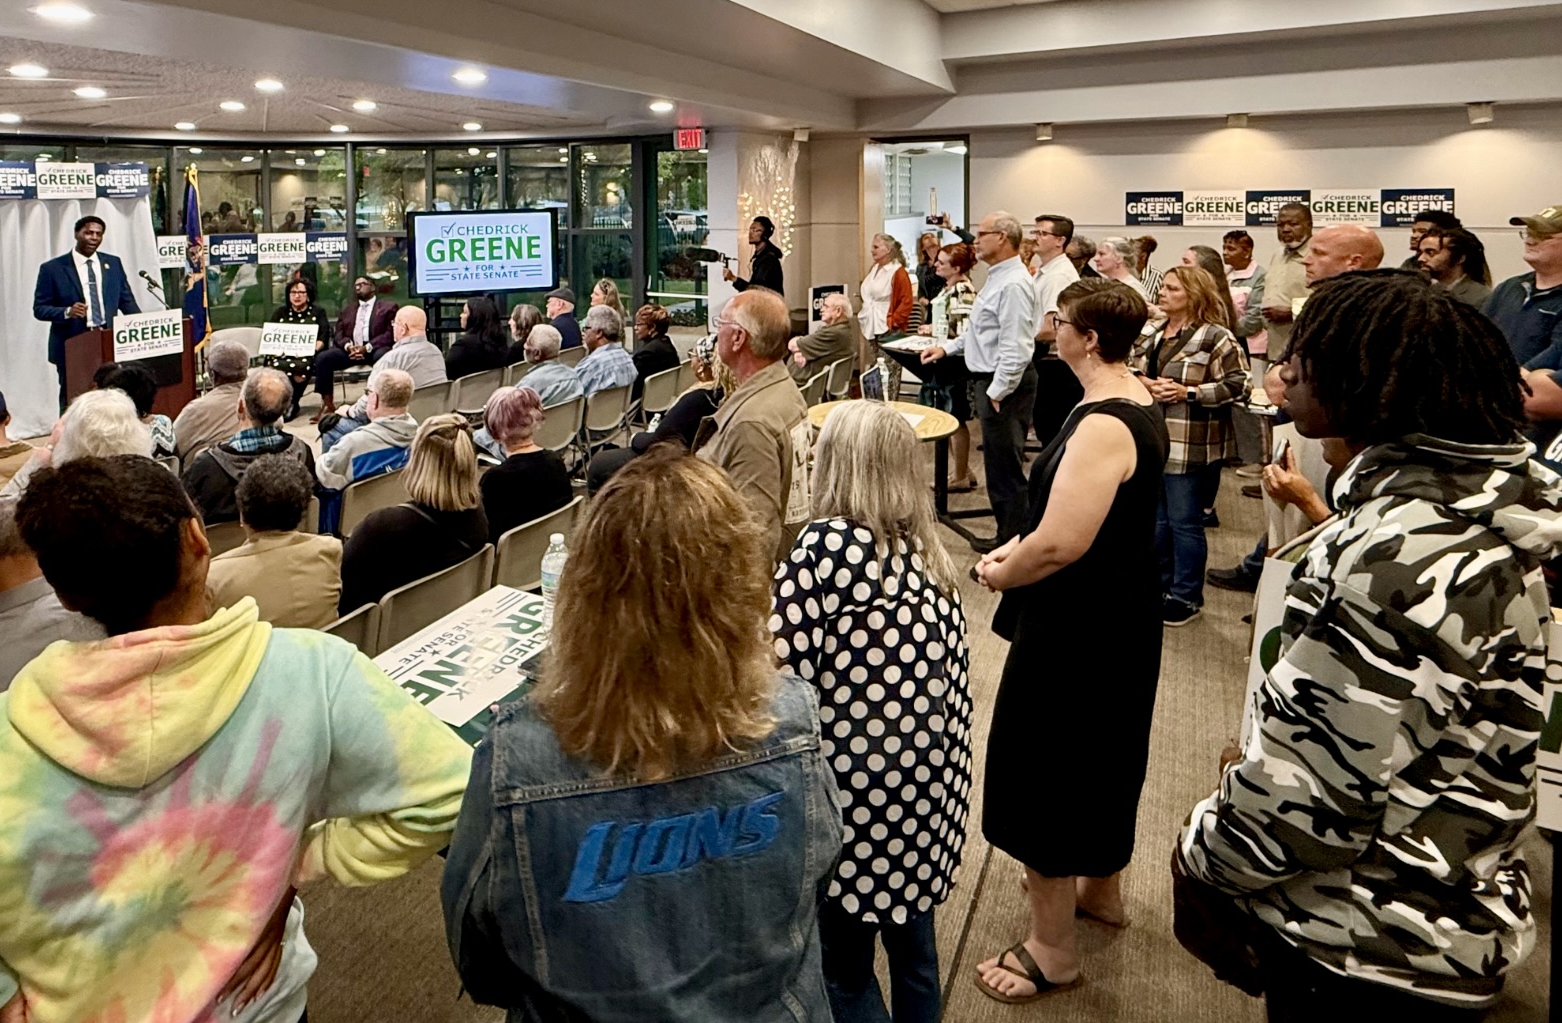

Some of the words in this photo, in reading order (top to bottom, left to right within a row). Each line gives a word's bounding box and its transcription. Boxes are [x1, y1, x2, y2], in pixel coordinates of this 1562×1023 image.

[679, 129, 701, 148] EXIT
[39, 174, 94, 185] GREENE
[96, 174, 149, 186] GREENE
[1127, 202, 1183, 214] GREENE
[1185, 202, 1244, 213] GREENE
[1312, 201, 1379, 213] GREENE
[457, 224, 528, 236] CHEDRICK
[210, 243, 257, 256] GREENE
[259, 242, 304, 253] GREENE
[425, 235, 541, 263] GREENE
[451, 273, 480, 281] STATE
[483, 271, 519, 279] SENATE
[133, 316, 174, 328] CHEDRICK
[115, 323, 181, 344] GREENE
[263, 333, 315, 344] GREENE
[398, 632, 453, 666] SENATE
[446, 632, 549, 701] CHEDRCK
[561, 790, 786, 903] LIONS
